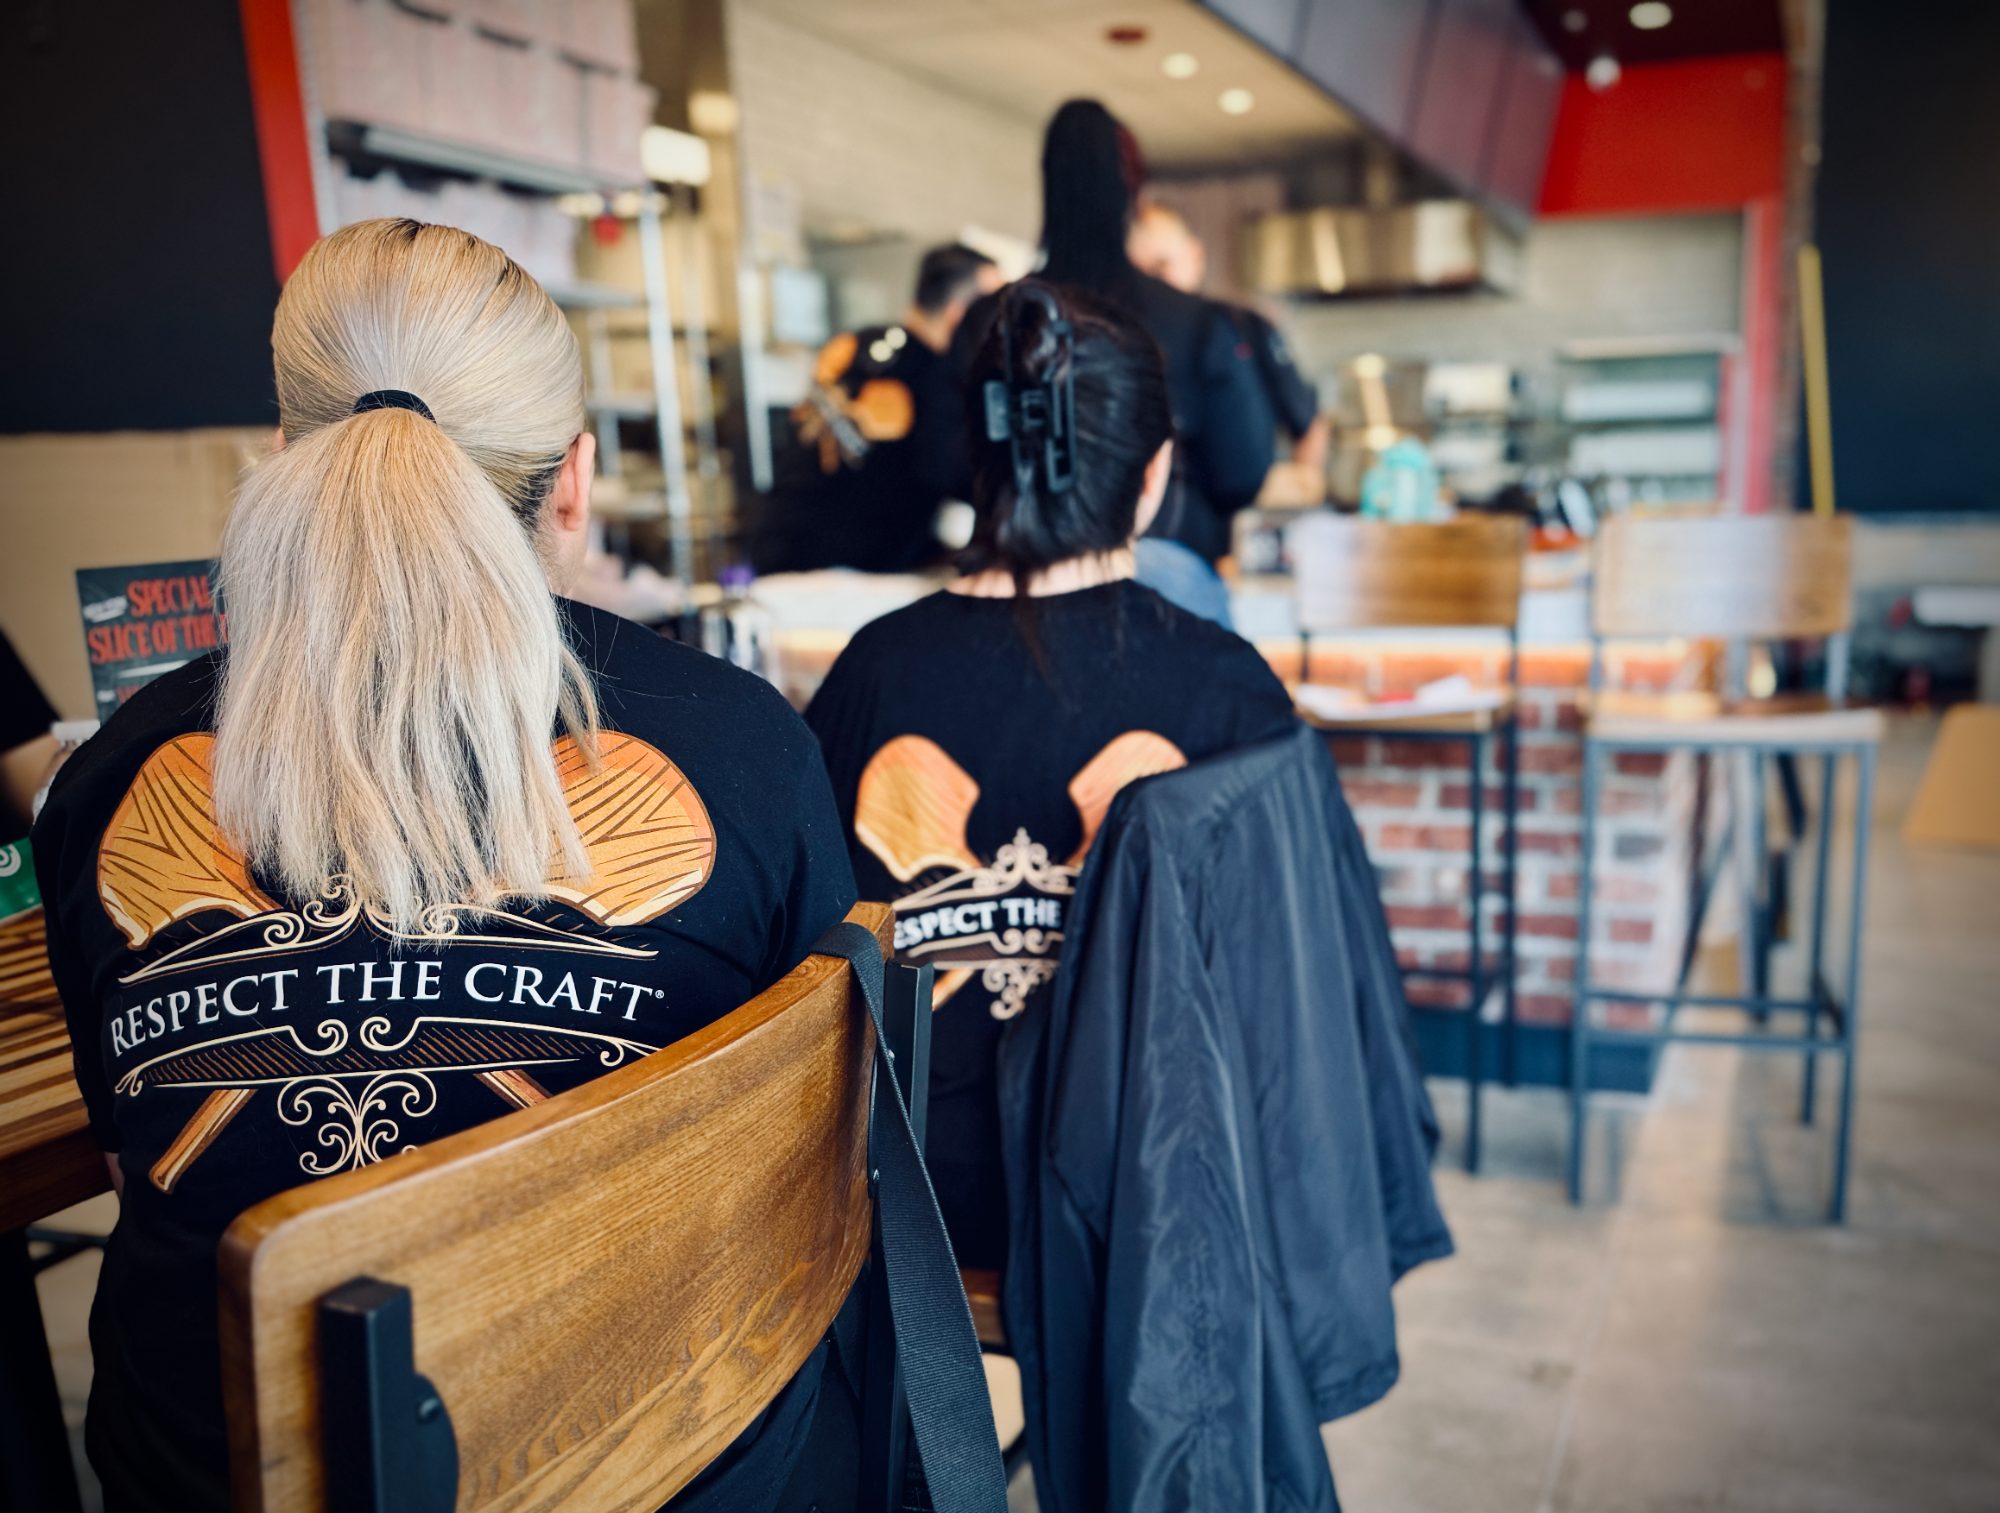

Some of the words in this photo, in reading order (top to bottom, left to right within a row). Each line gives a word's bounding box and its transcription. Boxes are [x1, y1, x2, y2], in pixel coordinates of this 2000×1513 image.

[88, 621, 152, 665] SLICE
[152, 618, 177, 655] OF
[179, 613, 217, 650] THE
[894, 901, 998, 949] ESPECT
[1001, 898, 1061, 927] THE
[110, 968, 299, 1057] RESPECT
[316, 960, 441, 1004] THE
